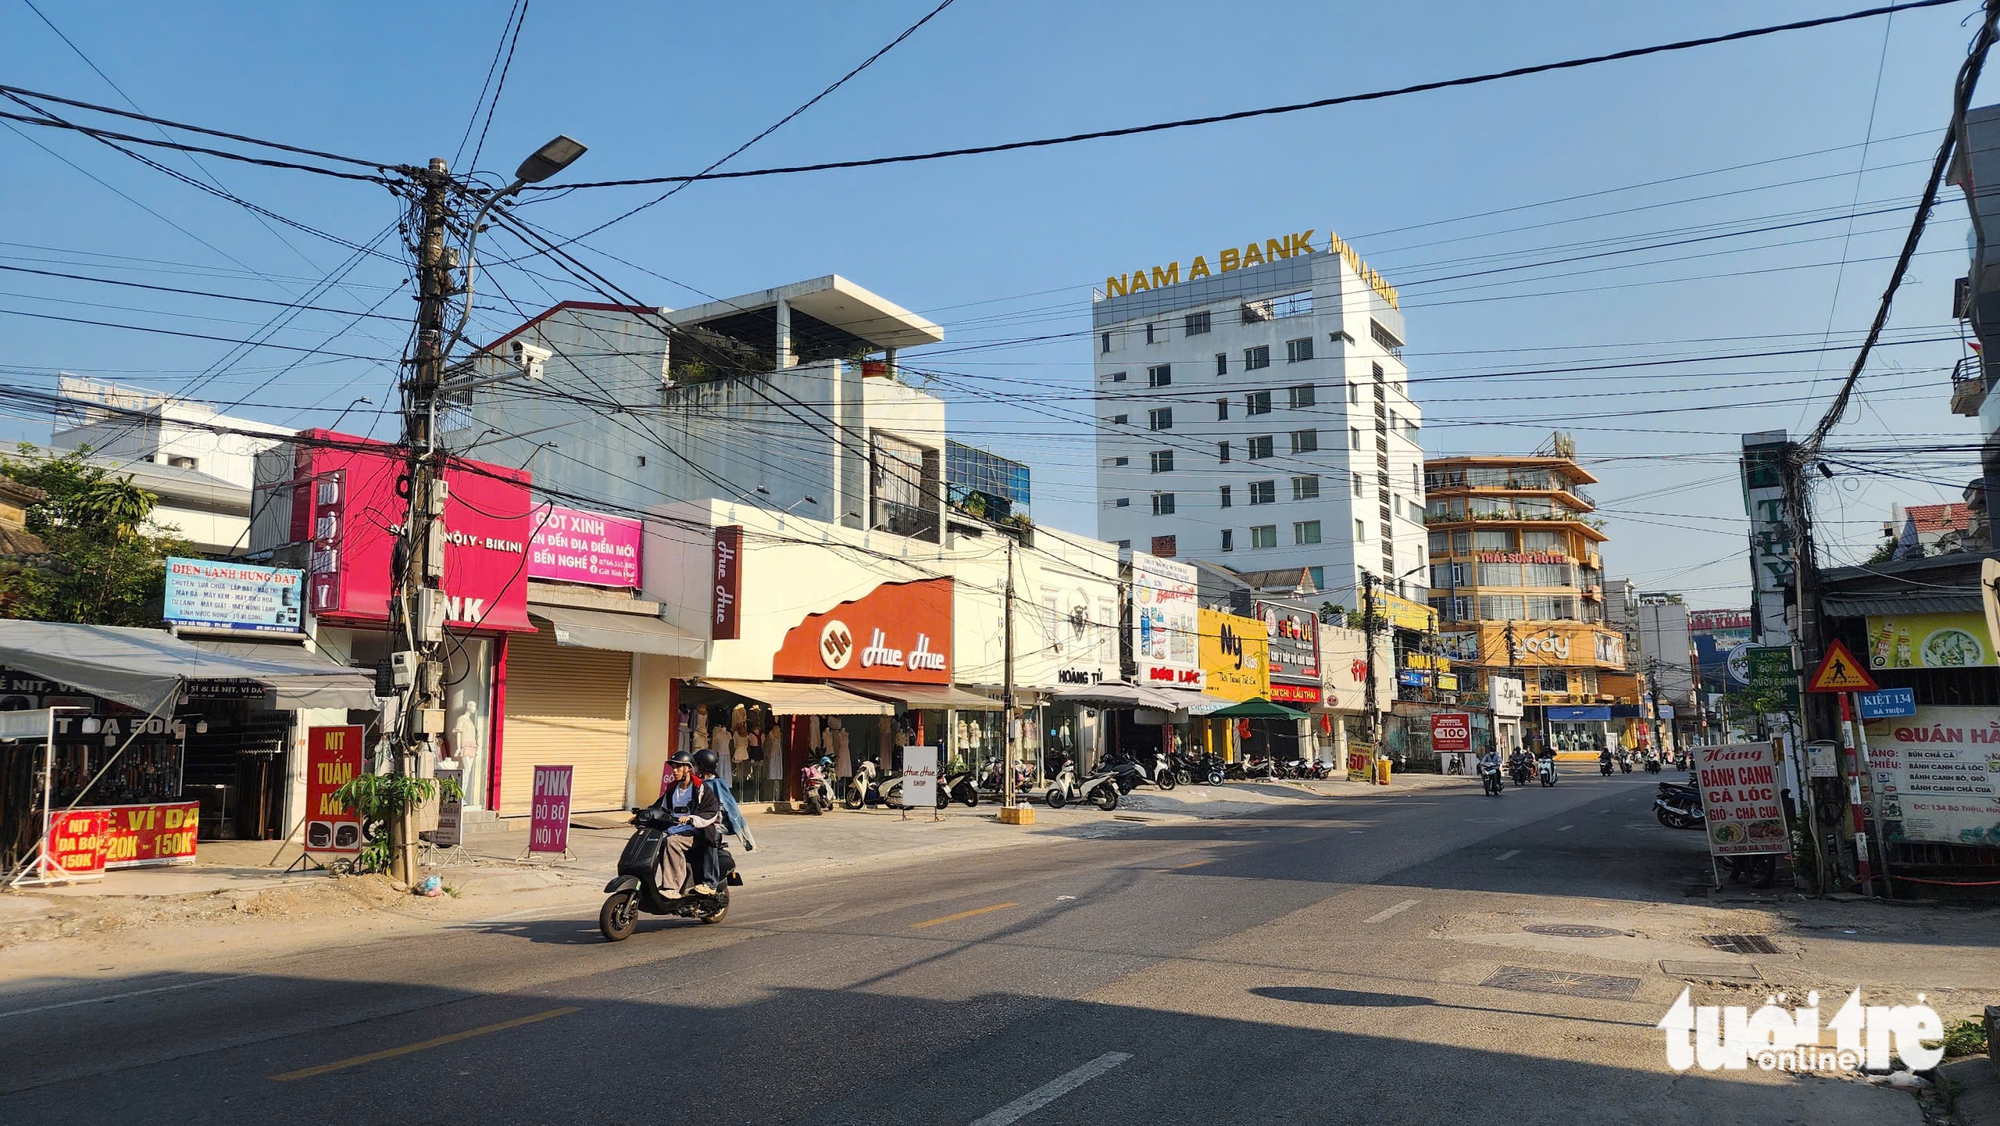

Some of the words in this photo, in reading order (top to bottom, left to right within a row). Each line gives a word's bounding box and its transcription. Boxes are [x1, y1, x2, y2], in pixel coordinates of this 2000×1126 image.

[1106, 261, 1180, 298] NAM
[1188, 255, 1212, 281] A
[1220, 229, 1315, 273] BANK
[1331, 231, 1359, 274] NAM
[1370, 268, 1399, 312] BANK
[570, 516, 605, 536] XINH
[485, 537, 522, 554] BIKINI
[717, 541, 735, 580] Hue
[172, 563, 201, 577] ĐIỆN
[205, 566, 236, 580] LẠNH
[240, 569, 271, 583] HƯNG
[274, 574, 297, 586] ĐẠT
[715, 585, 734, 625] Hue
[861, 627, 905, 668] Hue
[907, 632, 946, 671] Hue
[1513, 631, 1571, 660] yody
[1863, 693, 1892, 707] KIỆT
[1894, 694, 1911, 704] 134
[1873, 706, 1884, 715] BÀ
[325, 731, 345, 754] NỊT
[1895, 723, 1963, 743] QUÁN
[317, 755, 353, 785] TUẤN
[904, 765, 919, 777] Hue
[920, 765, 936, 777] Hue
[1701, 765, 1737, 787] BÁNH
[1738, 765, 1774, 785] CANH
[535, 770, 571, 797] PINK
[1708, 787, 1734, 803] CÁ
[127, 805, 156, 831] VÍ
[165, 807, 199, 829] DA
[535, 798, 548, 820] ĐỒ
[551, 801, 566, 824] BỘ
[1736, 803, 1757, 819] CHẢ
[1759, 805, 1780, 819] CUA
[69, 819, 91, 836] NỊT
[535, 825, 551, 848] NỘI
[555, 829, 562, 845] Y
[59, 837, 76, 852] DA
[154, 831, 193, 856] 150K
[60, 853, 93, 869] 150K
